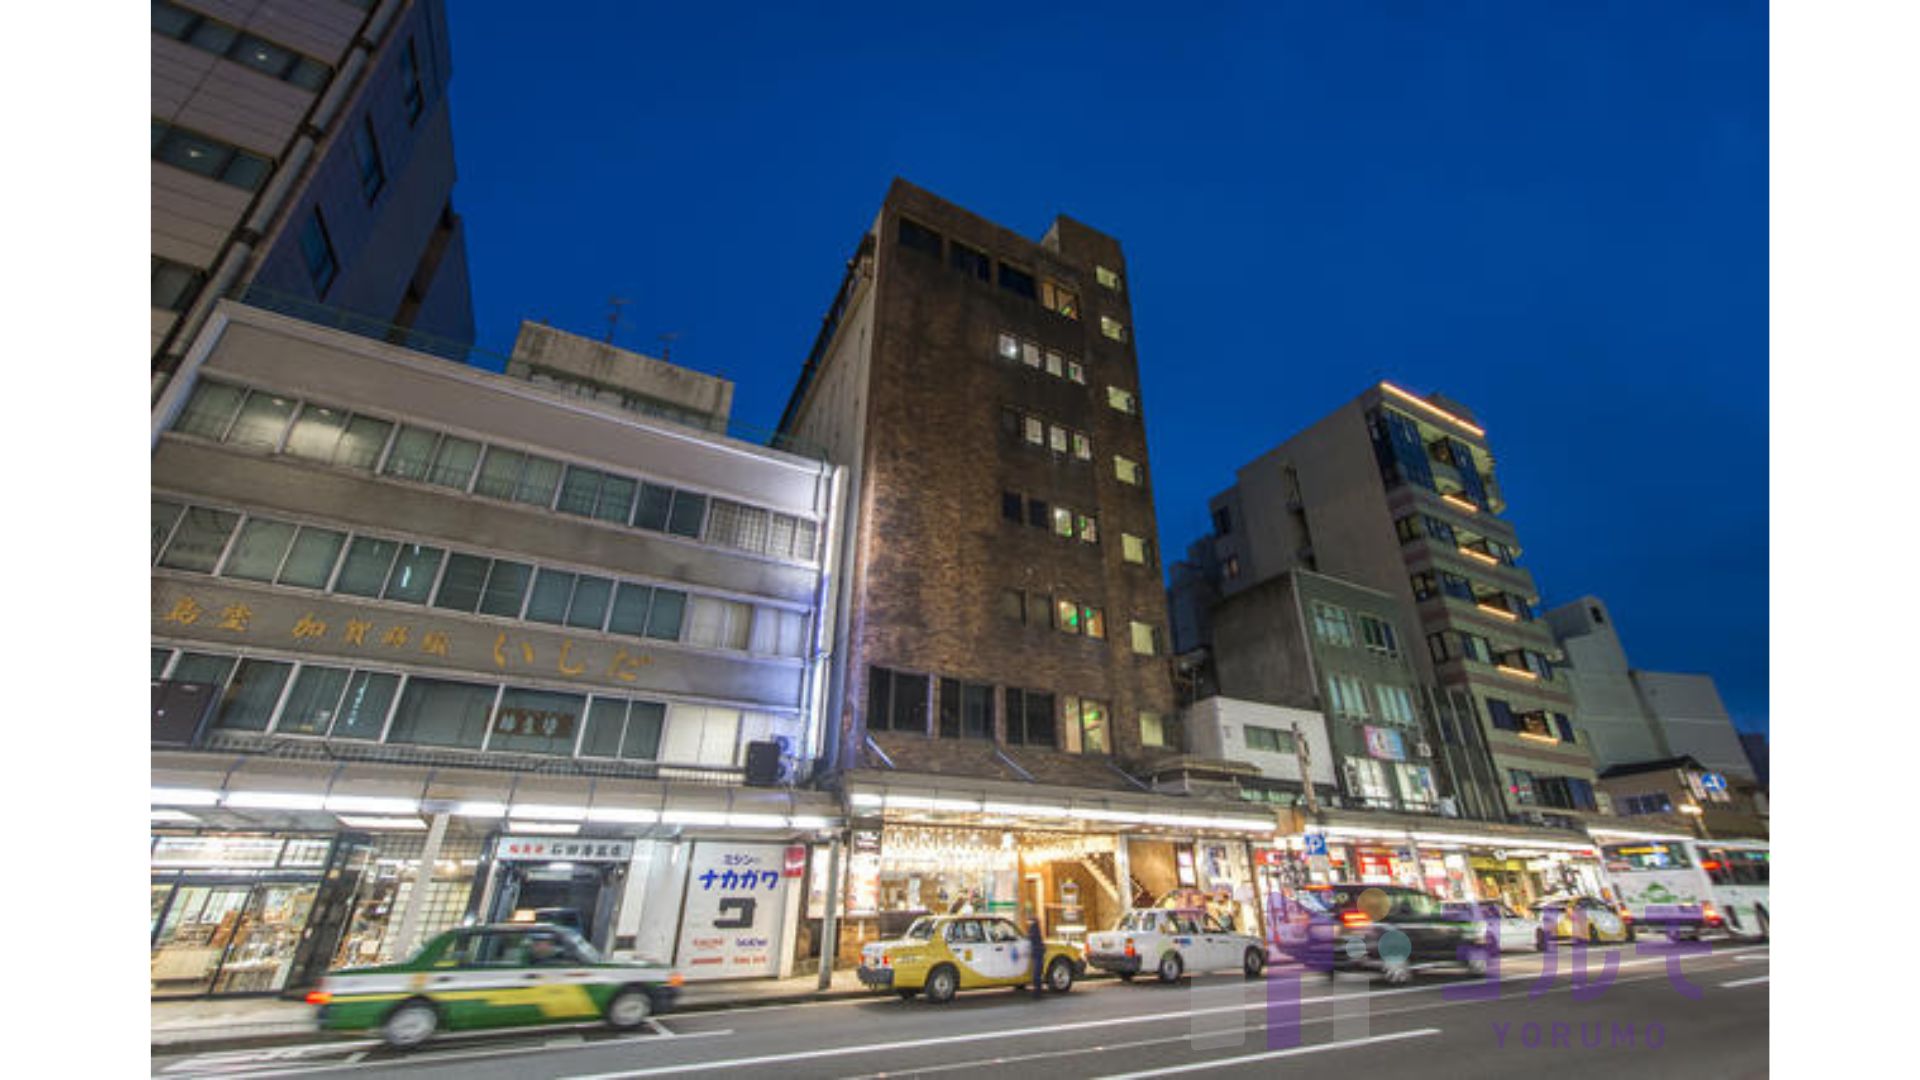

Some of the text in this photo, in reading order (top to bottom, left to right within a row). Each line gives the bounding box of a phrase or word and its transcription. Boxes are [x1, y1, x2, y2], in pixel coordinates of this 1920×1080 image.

[493, 631, 655, 682] いしだ
[698, 869, 779, 891] ナカガワ
